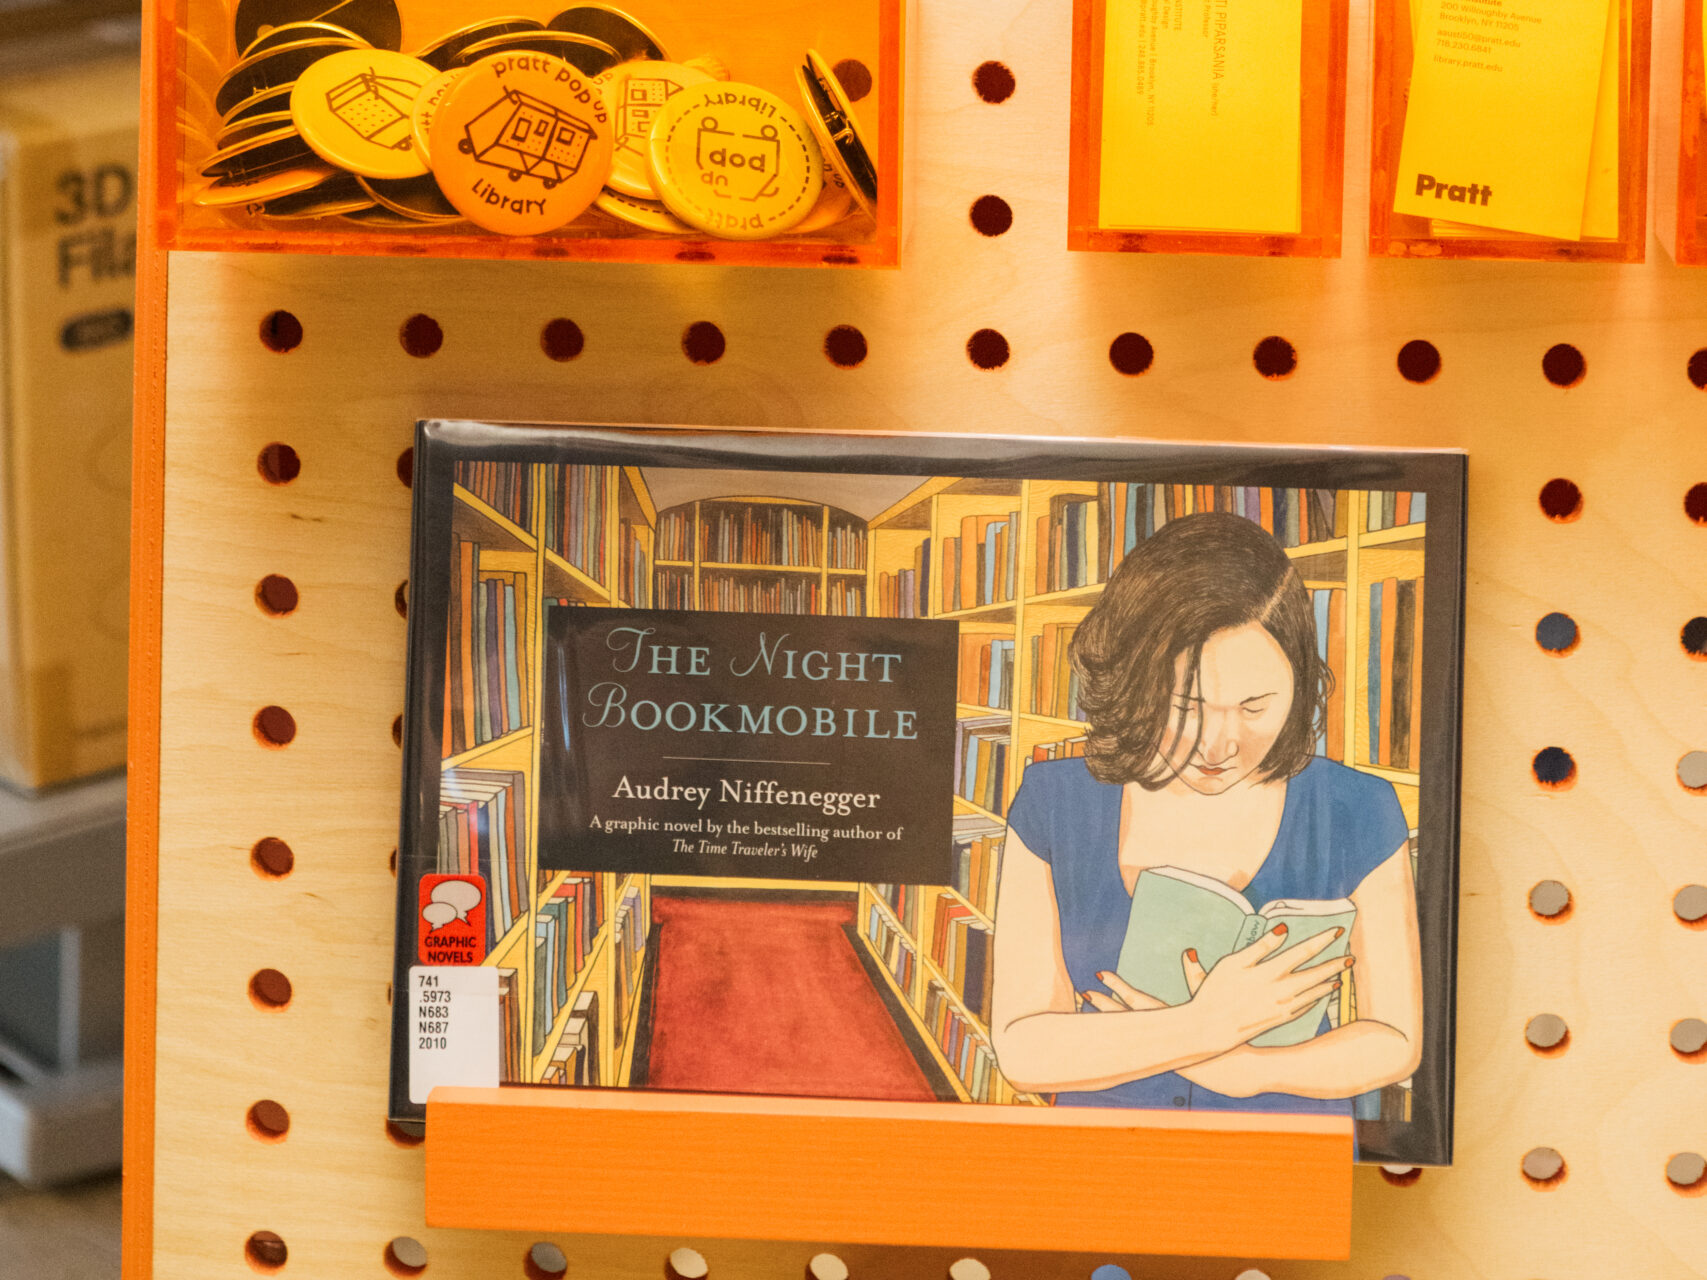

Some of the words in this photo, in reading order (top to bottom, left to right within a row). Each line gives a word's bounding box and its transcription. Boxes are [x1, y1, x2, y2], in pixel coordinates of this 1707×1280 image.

[1441, 1, 1460, 12] 200
[1461, 3, 1509, 19] Willoughby
[1510, 12, 1542, 24] Avenue
[1481, 18, 1494, 27] NY
[1212, 12, 1228, 80] PIPARSANIA
[1434, 55, 1503, 72] library.pratt.edu
[491, 56, 551, 78] pratt
[554, 67, 591, 104] pop
[593, 100, 607, 123] up
[703, 92, 777, 119] Library
[709, 148, 766, 173] pop
[700, 171, 729, 187] up
[1415, 173, 1492, 206] Pratt
[54, 164, 133, 226] 3D
[472, 178, 547, 216] Library
[707, 207, 764, 231] pratt
[612, 775, 711, 810] Audrey
[719, 779, 880, 816] Niffenegger
[589, 814, 602, 829] A
[605, 817, 659, 835] graphic
[664, 818, 702, 833] novel
[706, 820, 722, 837] by
[727, 820, 750, 835] the
[754, 822, 829, 842] bestselling
[833, 825, 882, 840] author
[886, 825, 904, 840] of
[672, 838, 695, 854] The
[698, 839, 727, 856] Time
[791, 844, 818, 862] Wife
[424, 936, 476, 948] GRAPHIC
[428, 952, 473, 963] NOVELS
[418, 976, 439, 987] 741
[419, 991, 451, 1003] .5973
[419, 1006, 449, 1018] N683
[419, 1022, 449, 1034] N687
[419, 1037, 447, 1049] 2010
